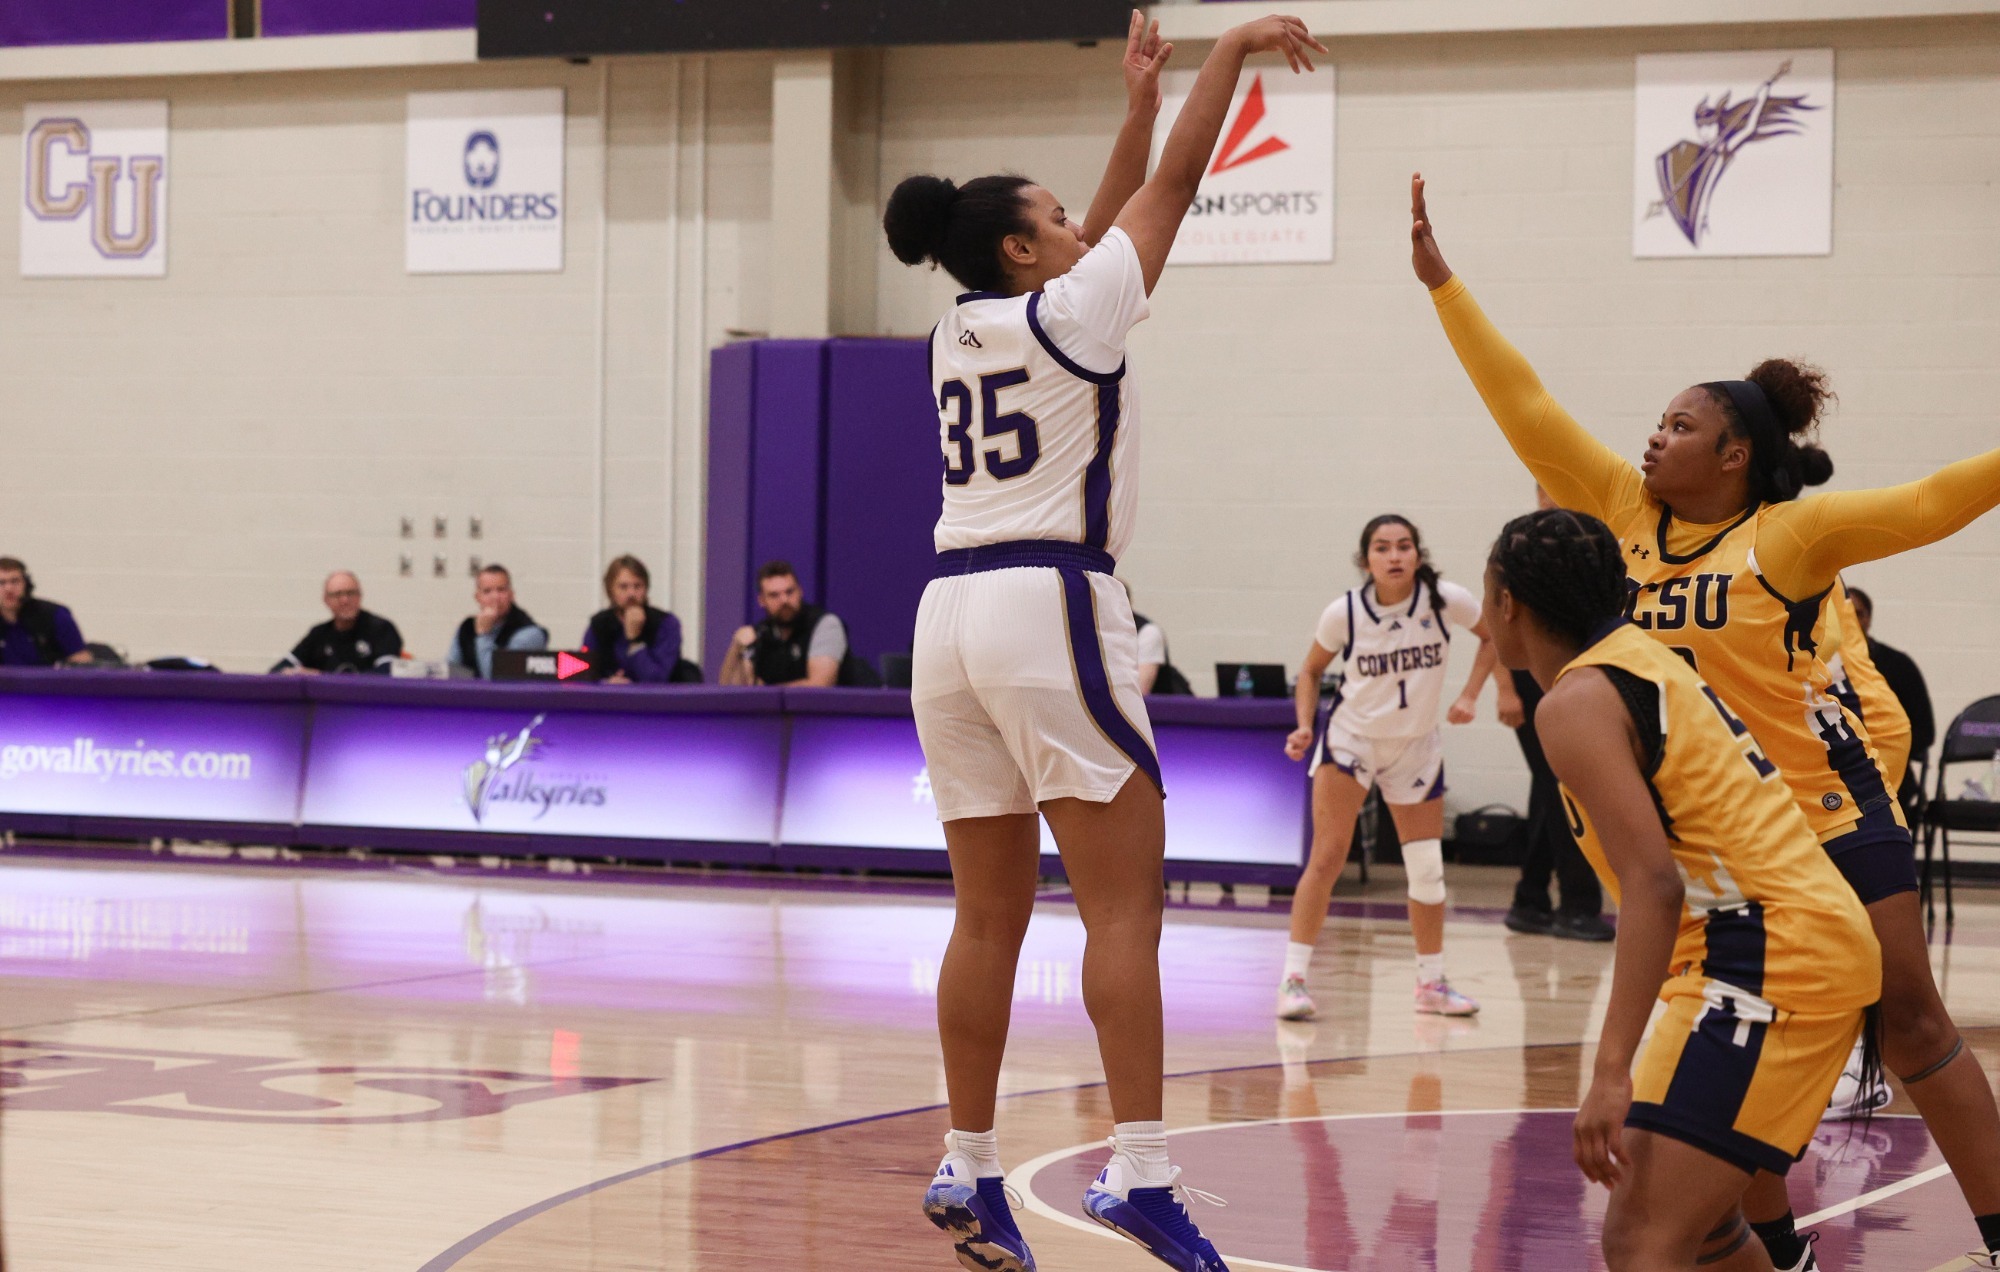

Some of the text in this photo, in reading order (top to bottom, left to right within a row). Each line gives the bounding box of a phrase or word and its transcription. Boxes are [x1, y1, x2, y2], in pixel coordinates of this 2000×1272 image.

[25, 117, 163, 259] CU
[412, 188, 558, 222] FOUNDERS
[1190, 195, 1224, 216] SN
[940, 365, 1042, 487] 35
[1622, 572, 1735, 631] CSU
[1357, 642, 1442, 677] CONVERSE
[1397, 679, 1408, 709] 1
[0, 737, 251, 783] govalkyries.com
